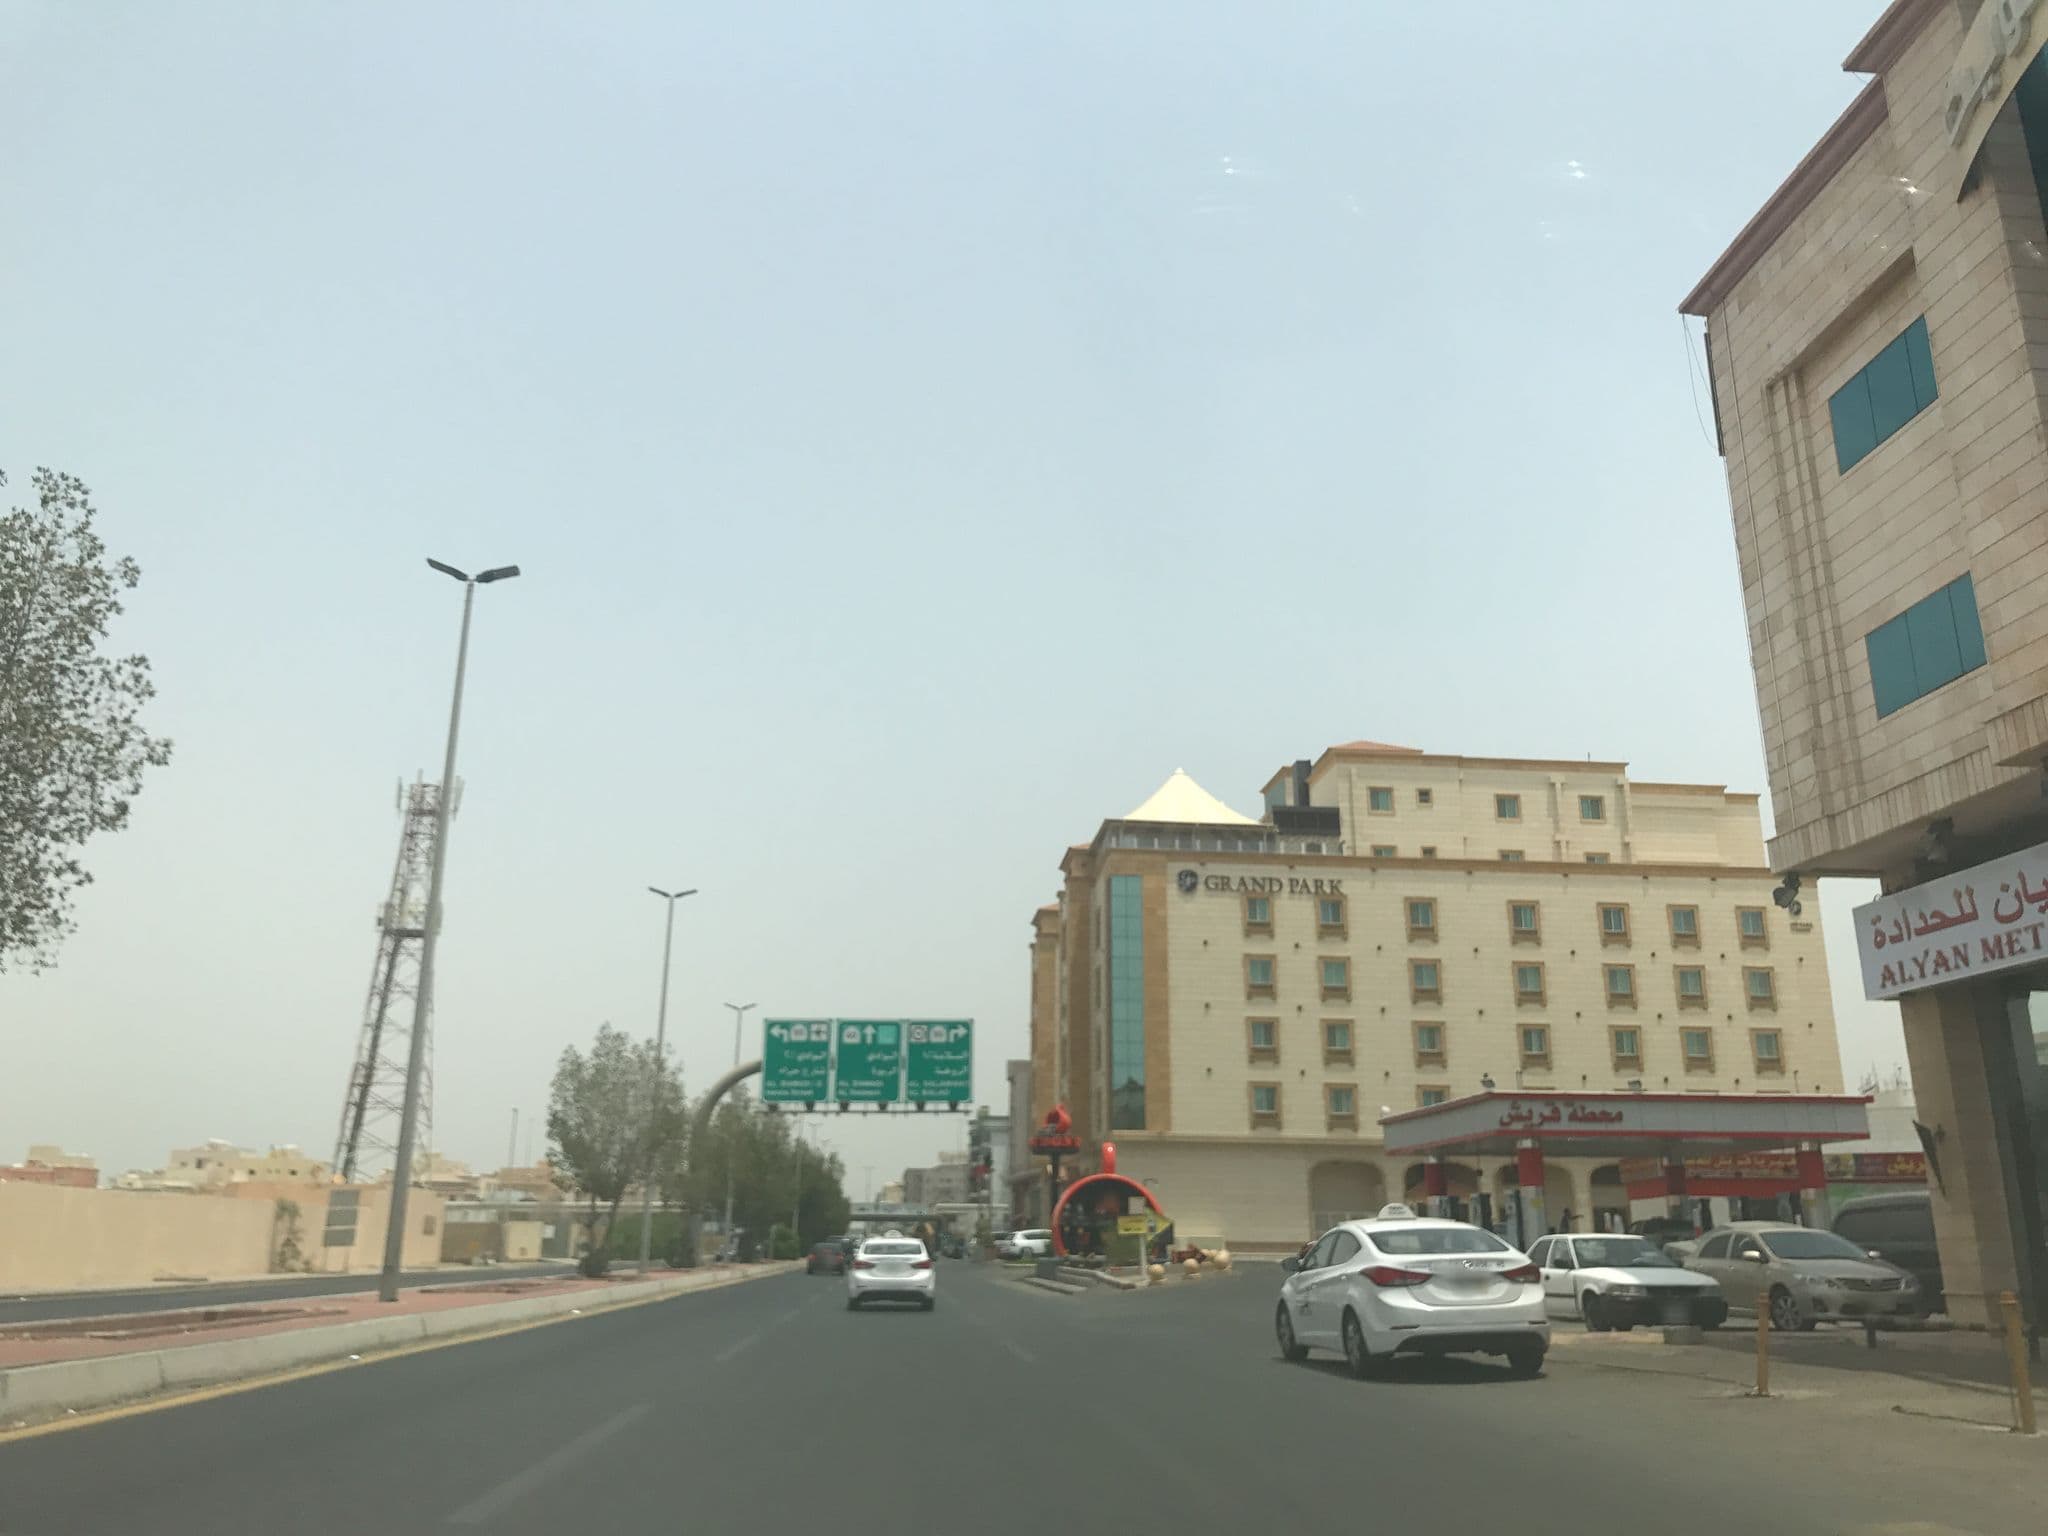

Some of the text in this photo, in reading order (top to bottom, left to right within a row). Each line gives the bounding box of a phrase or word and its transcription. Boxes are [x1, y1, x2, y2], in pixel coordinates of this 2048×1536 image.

[1204, 875, 1346, 896] GRAND PARK
[1871, 884, 1979, 949] للحدادة
[1880, 943, 1970, 989] ALYAN
[1499, 1100, 1623, 1128] محطة قريش
